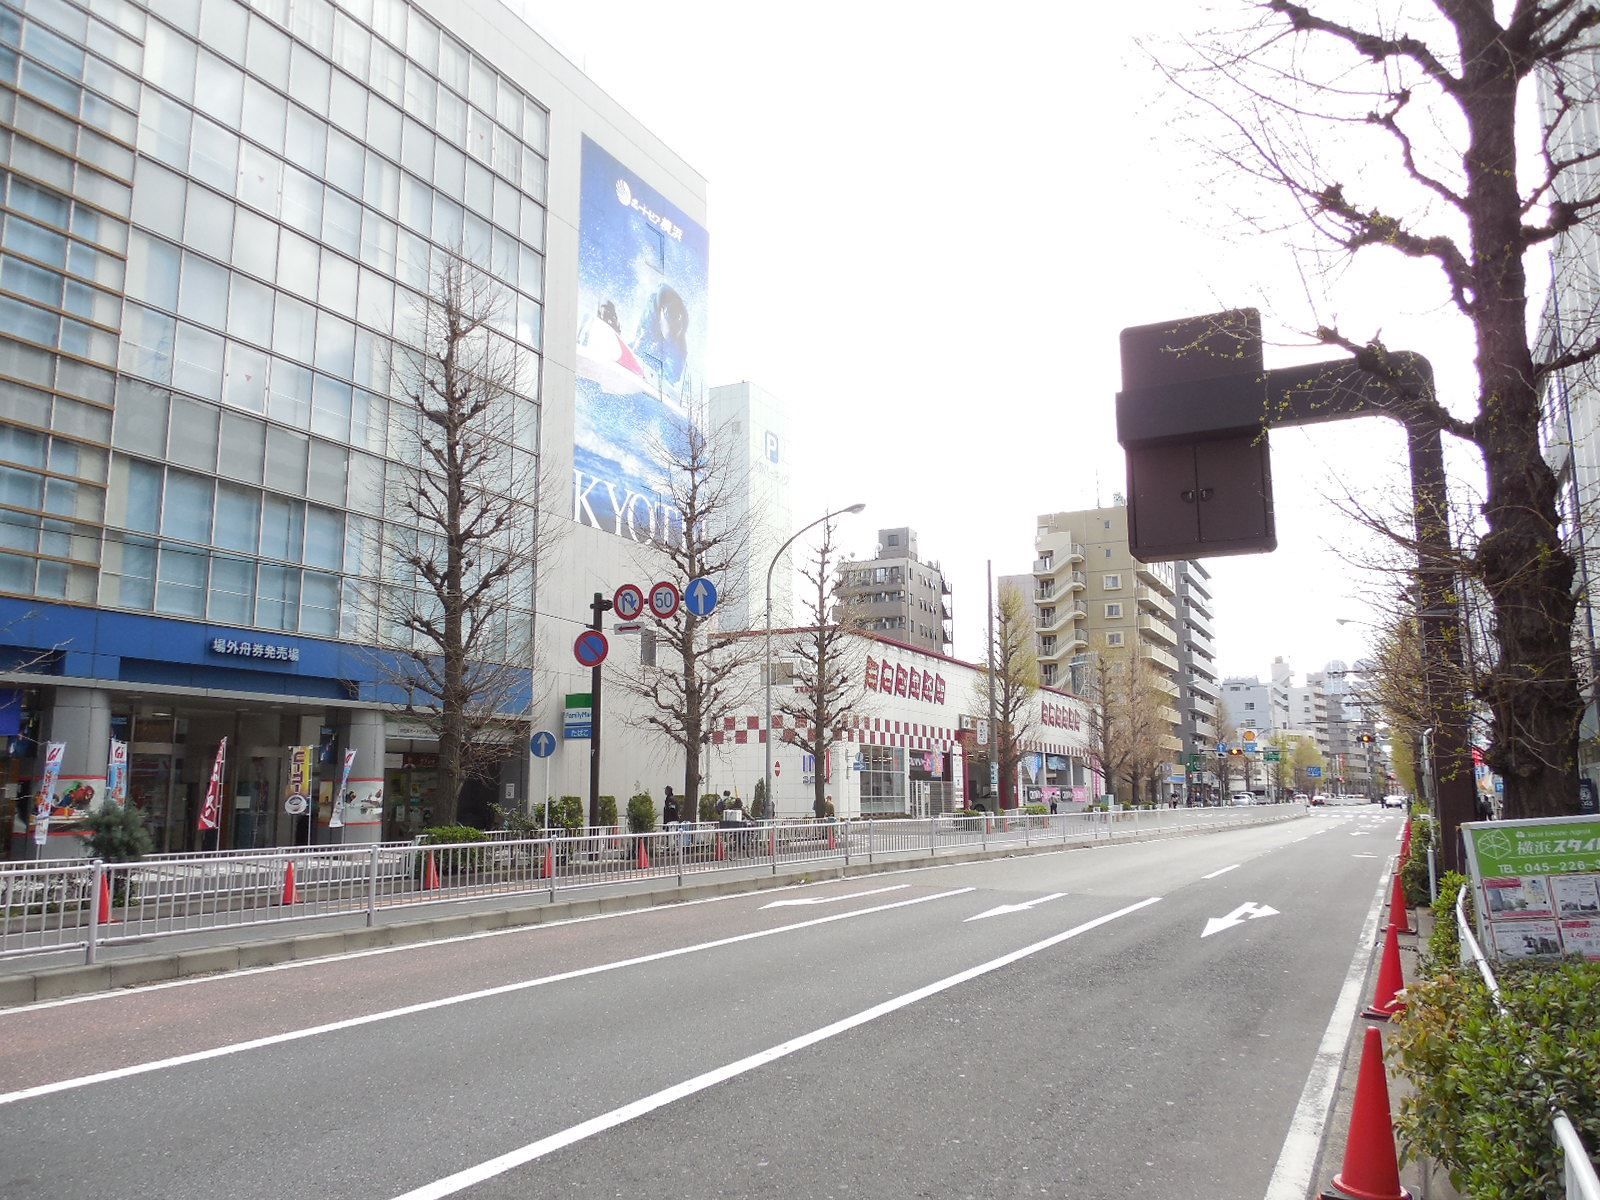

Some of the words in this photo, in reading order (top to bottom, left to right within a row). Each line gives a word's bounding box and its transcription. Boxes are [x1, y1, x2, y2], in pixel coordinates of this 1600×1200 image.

[766, 432, 778, 462] P
[655, 592, 673, 609] 50
[212, 637, 300, 662] 場外舟券発売場
[571, 729, 589, 737] たばこ
[1517, 838, 1600, 856] 横浜スタイ
